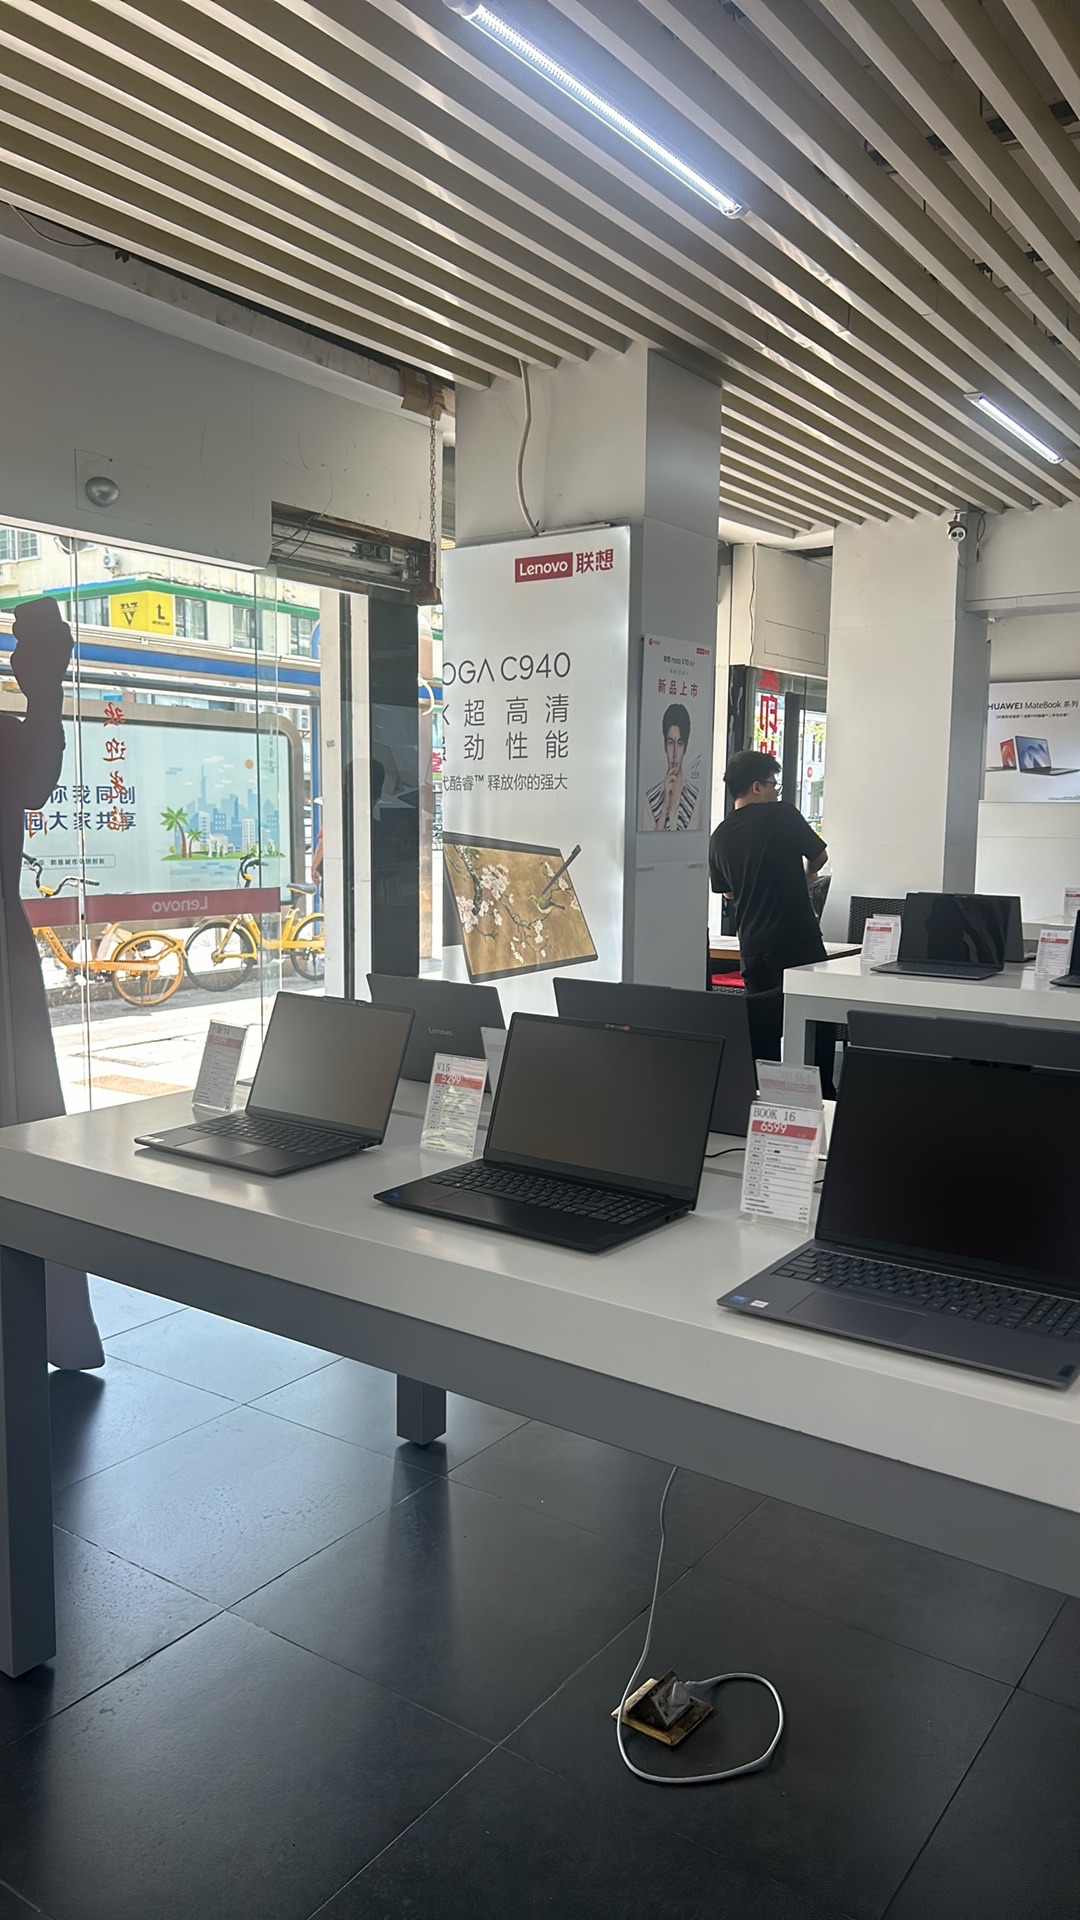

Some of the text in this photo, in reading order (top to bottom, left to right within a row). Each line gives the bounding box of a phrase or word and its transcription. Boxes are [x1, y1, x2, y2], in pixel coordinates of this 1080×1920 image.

[519, 548, 614, 577] Lenovo 联想
[500, 651, 571, 681] C940
[657, 678, 698, 698] 新品上市
[987, 700, 1079, 711] HUAWEI MateBook 系列
[487, 772, 569, 792] 释放你的强大
[427, 1026, 453, 1037] Lenovo
[436, 1062, 451, 1073] V15
[441, 1074, 462, 1086] 5299
[753, 1106, 796, 1122] BOOK 16
[760, 1121, 787, 1134] 6599
